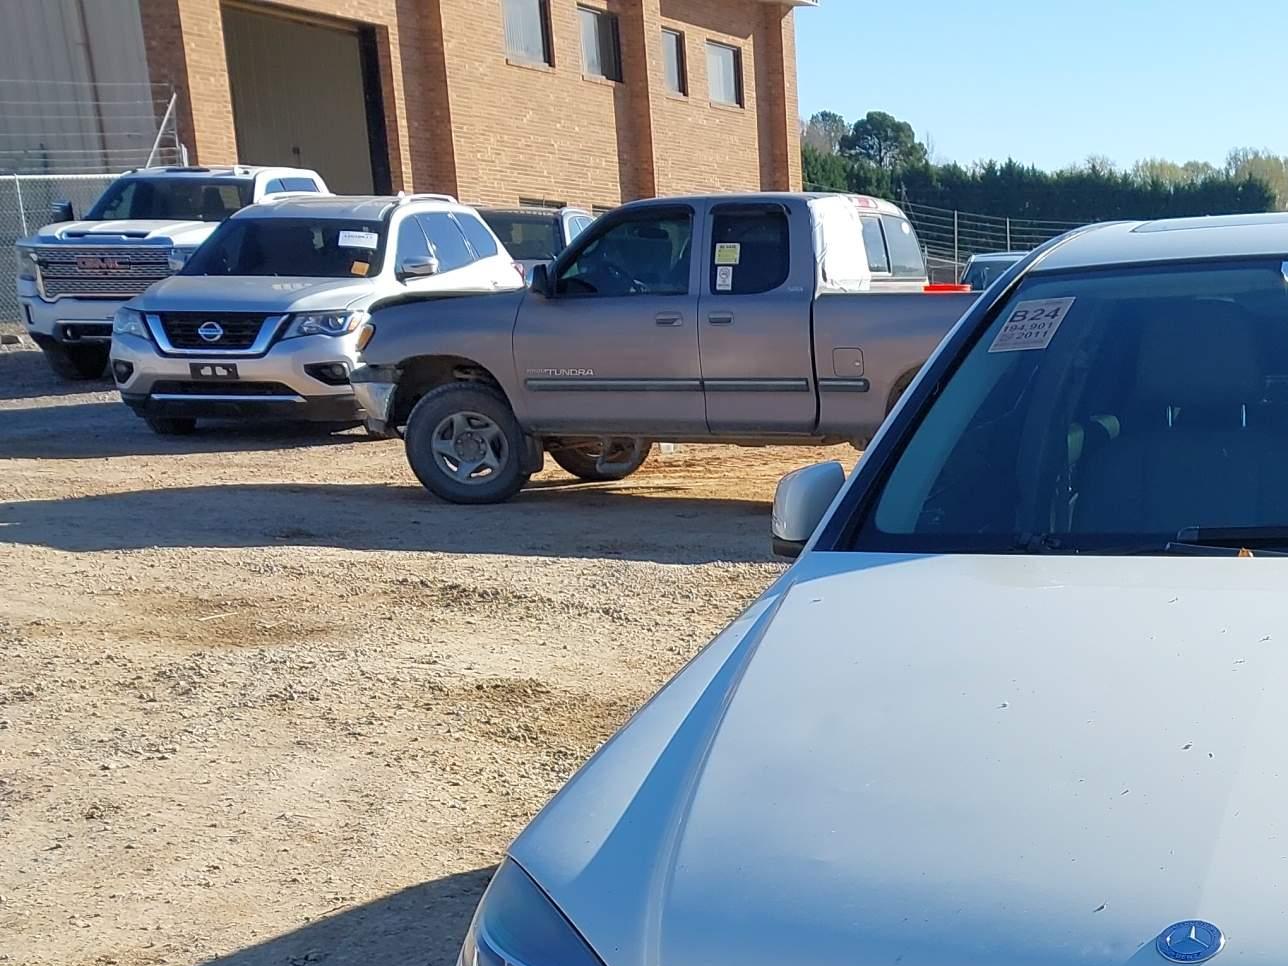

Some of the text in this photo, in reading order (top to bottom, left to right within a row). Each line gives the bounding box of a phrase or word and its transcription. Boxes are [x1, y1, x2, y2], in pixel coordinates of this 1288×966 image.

[1008, 306, 1061, 323] B24
[1015, 330, 1049, 340] 2011
[545, 368, 594, 376] TUNDRA
